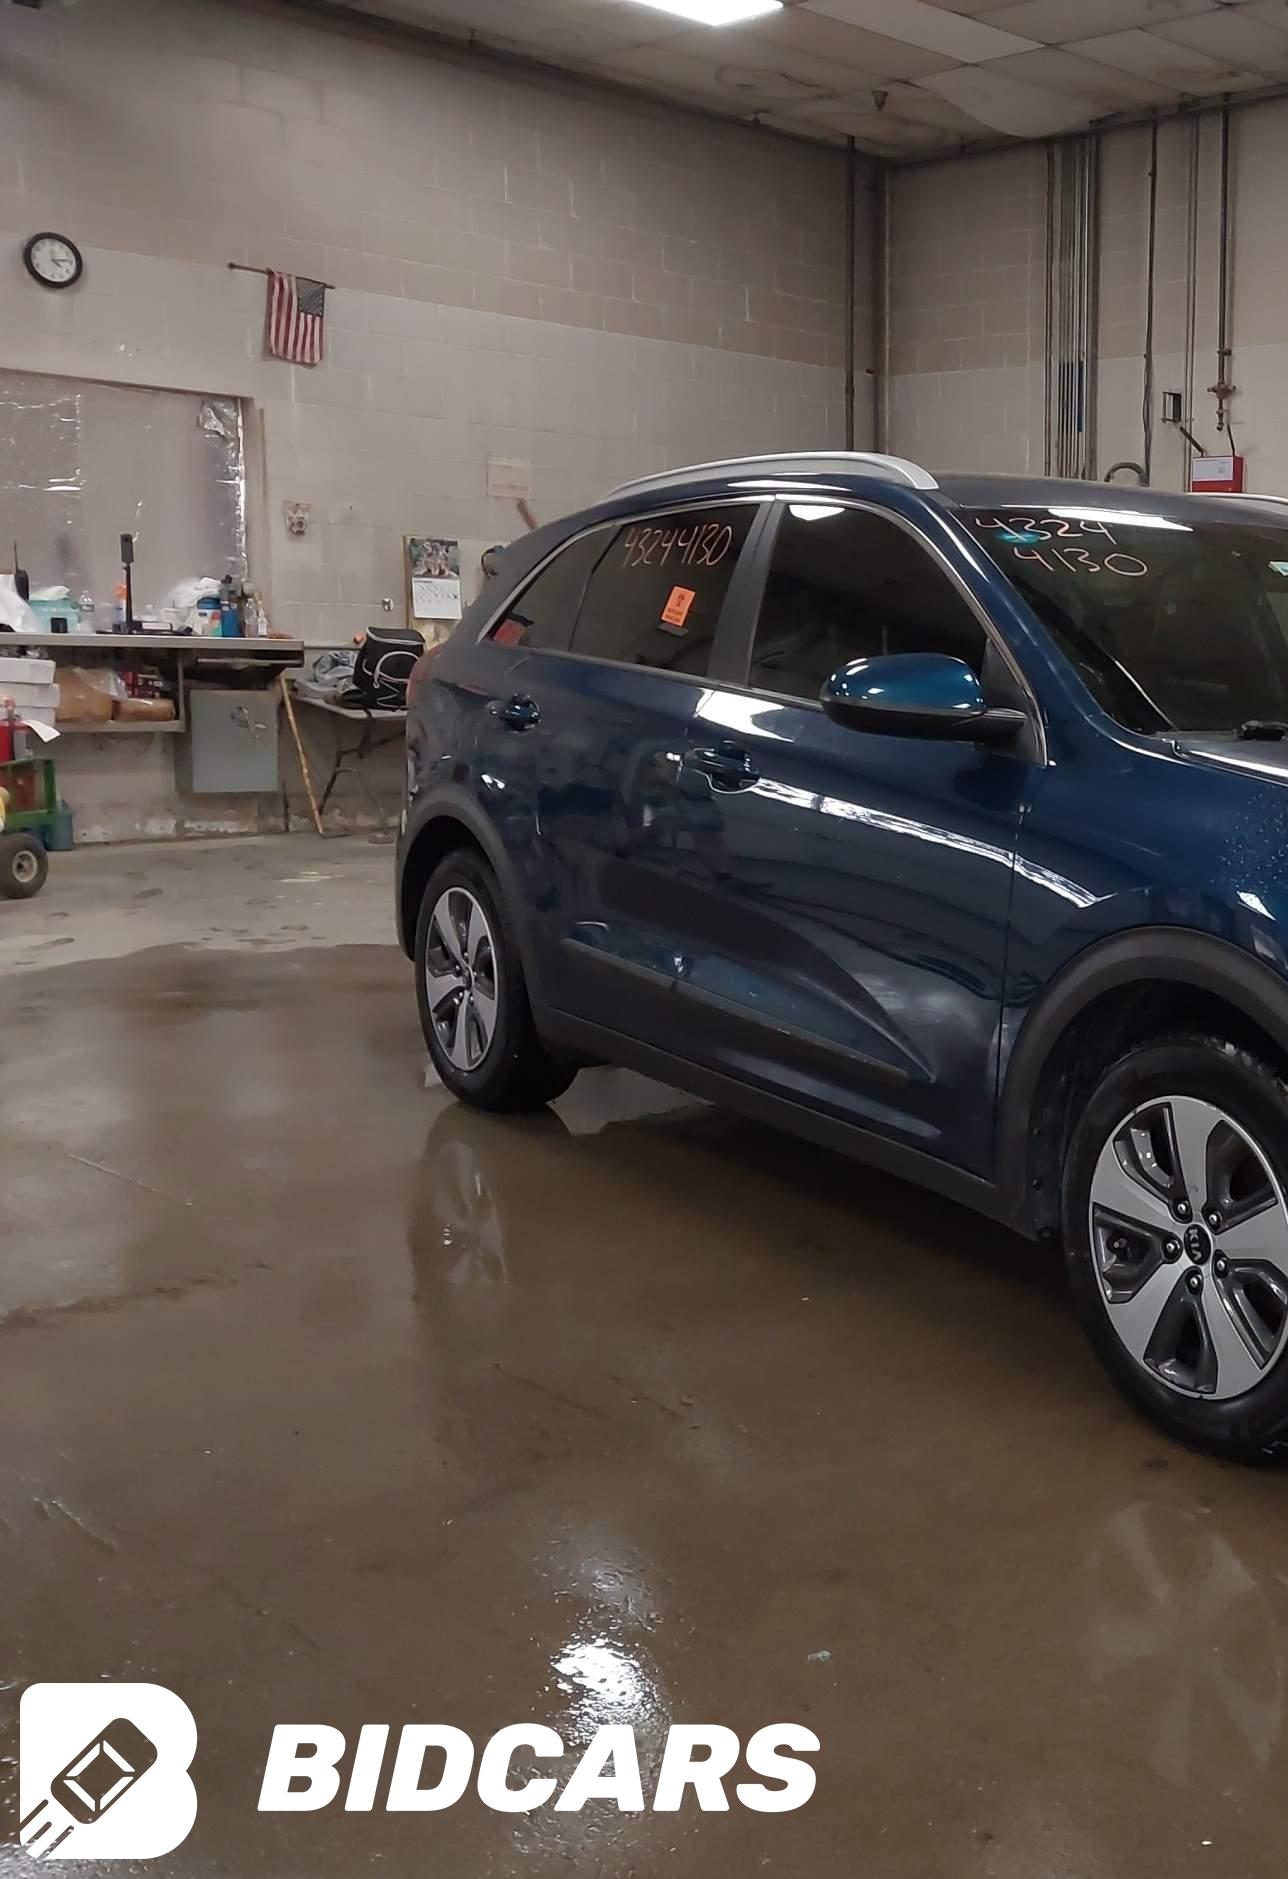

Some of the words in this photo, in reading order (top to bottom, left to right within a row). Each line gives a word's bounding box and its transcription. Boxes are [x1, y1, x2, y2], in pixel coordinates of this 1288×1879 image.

[622, 523, 732, 568] 43244130
[975, 517, 1118, 545] 4324
[1014, 546, 1148, 576] 4130
[1189, 1228, 1202, 1261] KIA
